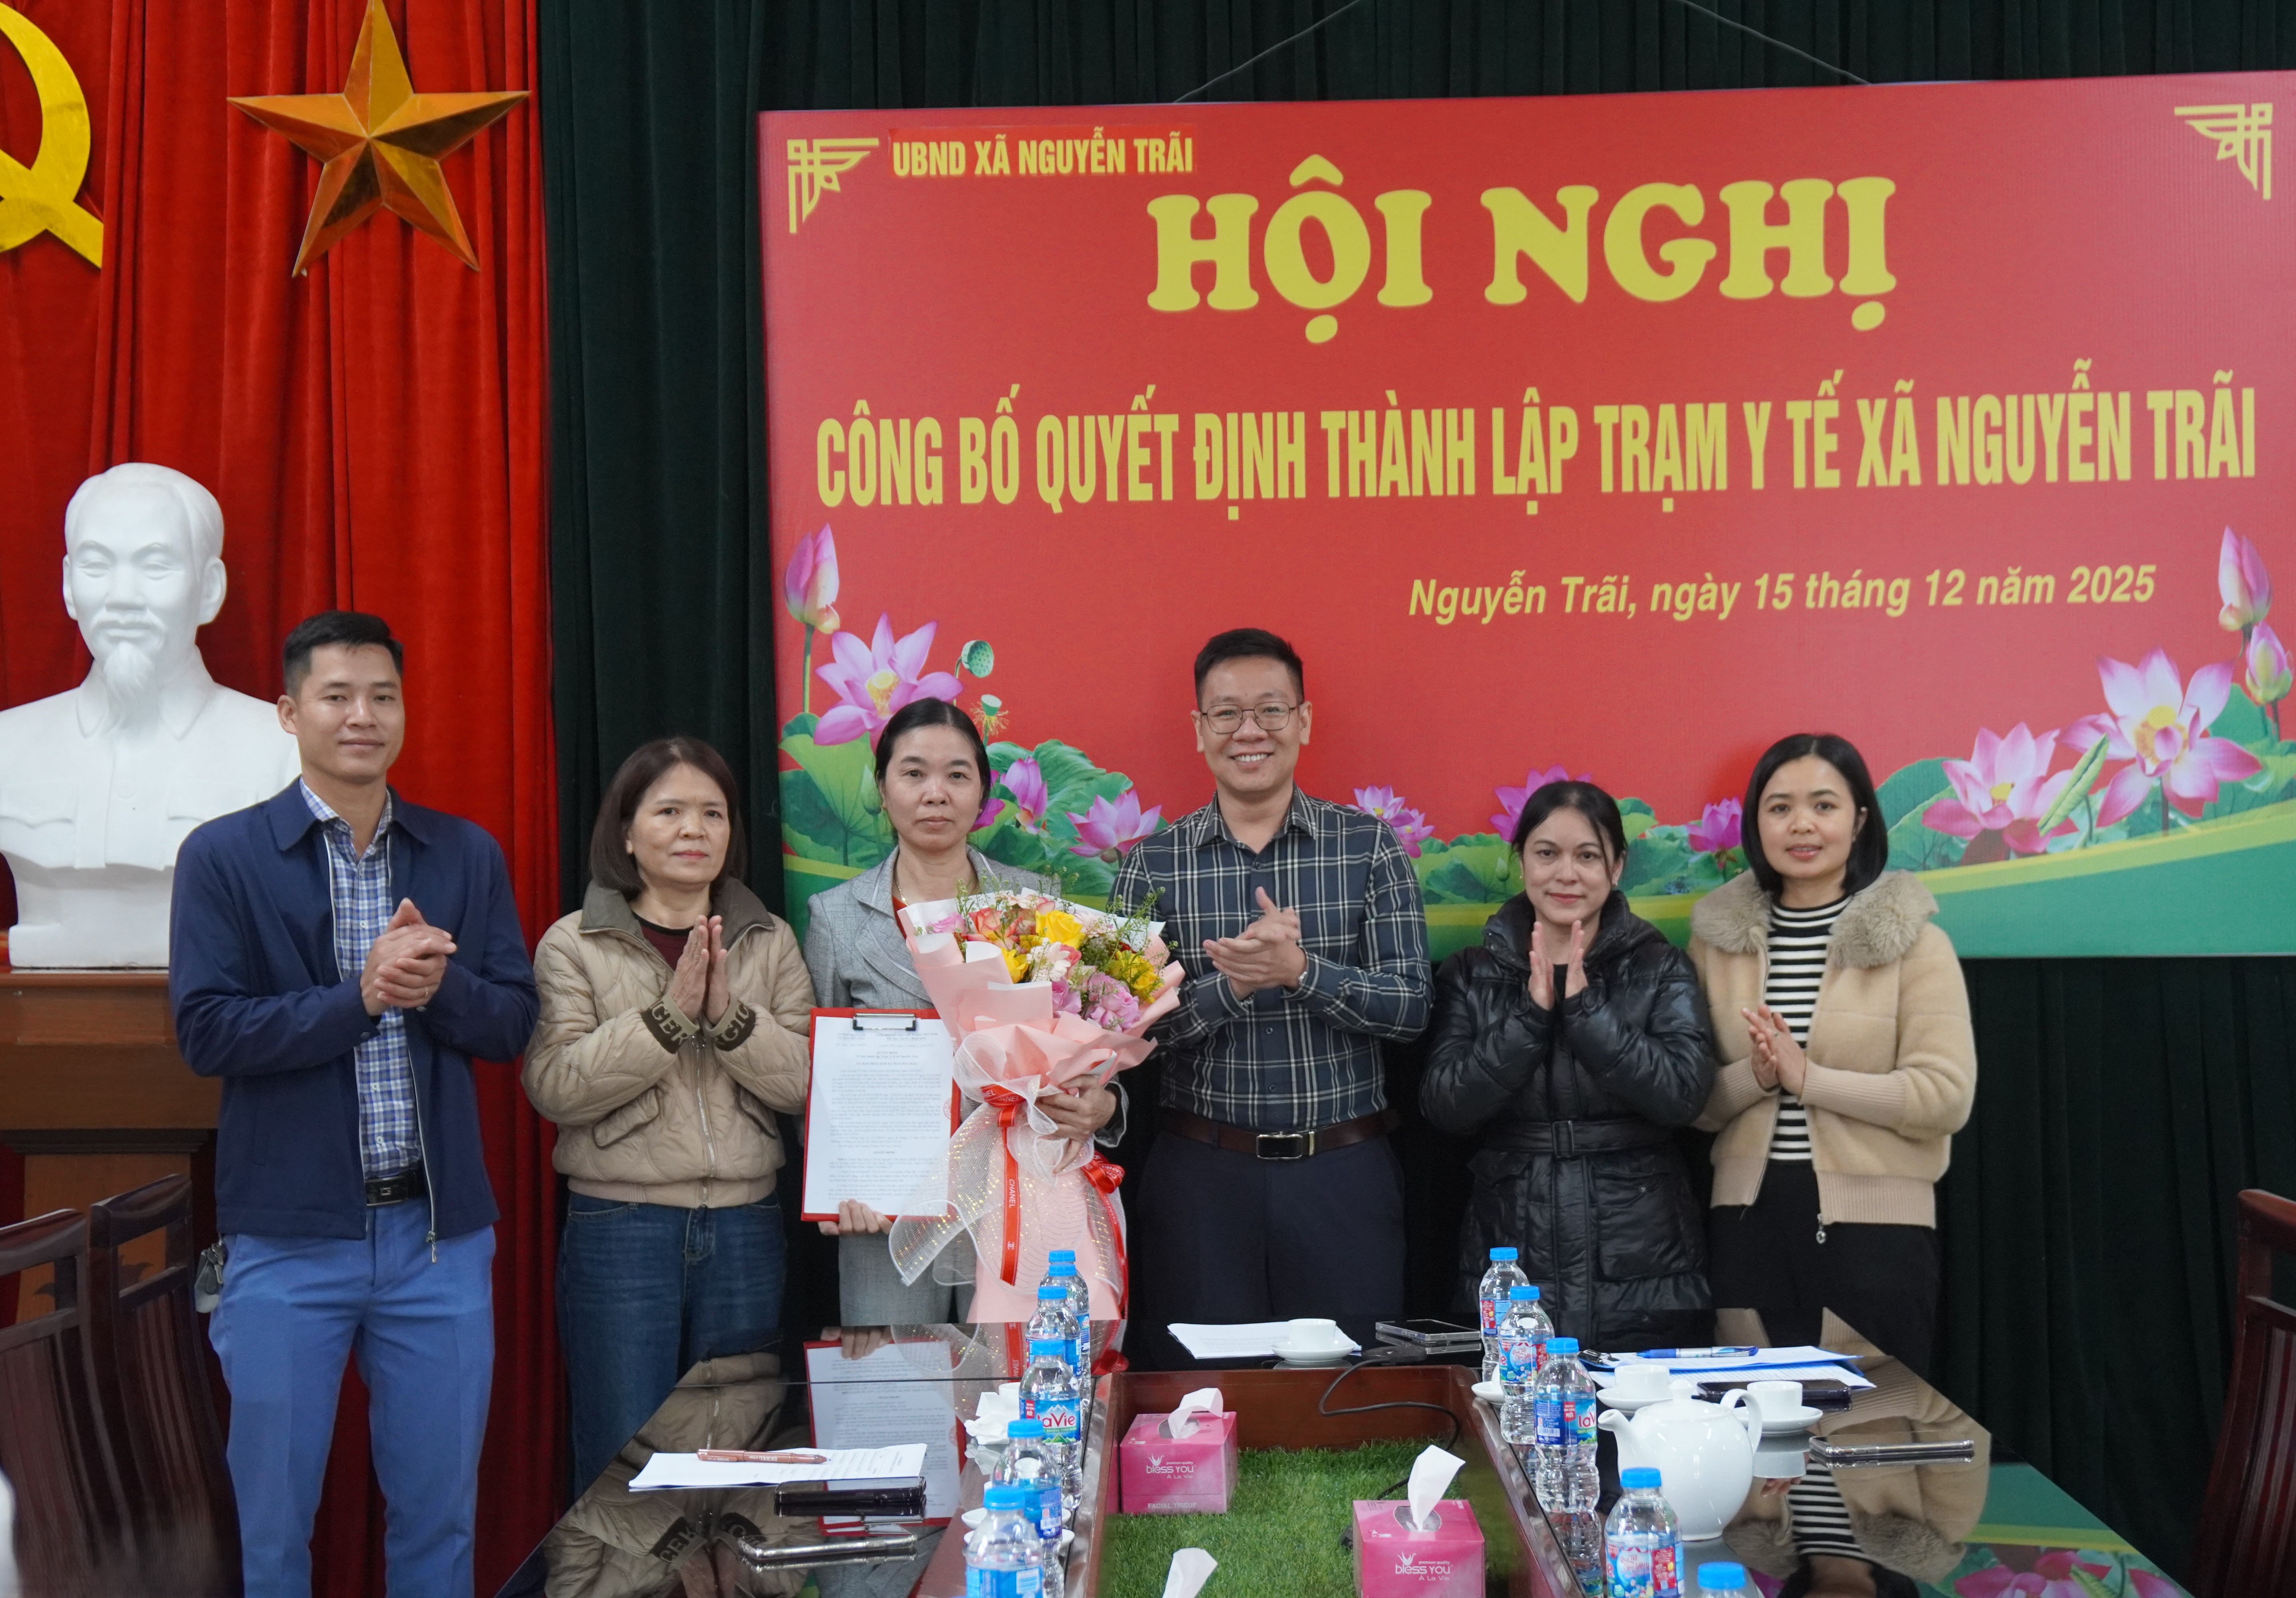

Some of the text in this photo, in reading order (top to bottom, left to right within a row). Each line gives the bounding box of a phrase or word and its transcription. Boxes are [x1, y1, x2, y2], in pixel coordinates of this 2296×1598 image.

[893, 127, 1193, 177] UBND XÃ NGUYỄN TRÃI
[1146, 154, 1896, 344] HỘI NGHỊ
[817, 359, 2255, 520] CÔNG BỐ QUYẾT ĐỊNH THÀNH LẬP TRẠM Y TẾ XÃ NGUYỄN TRÃI
[1409, 564, 2157, 625] Nguyễn Trãi, ngày 15 tháng 12 năm 2025
[1146, 1465, 1174, 1474] bless
[1395, 1564, 1428, 1574] bless
